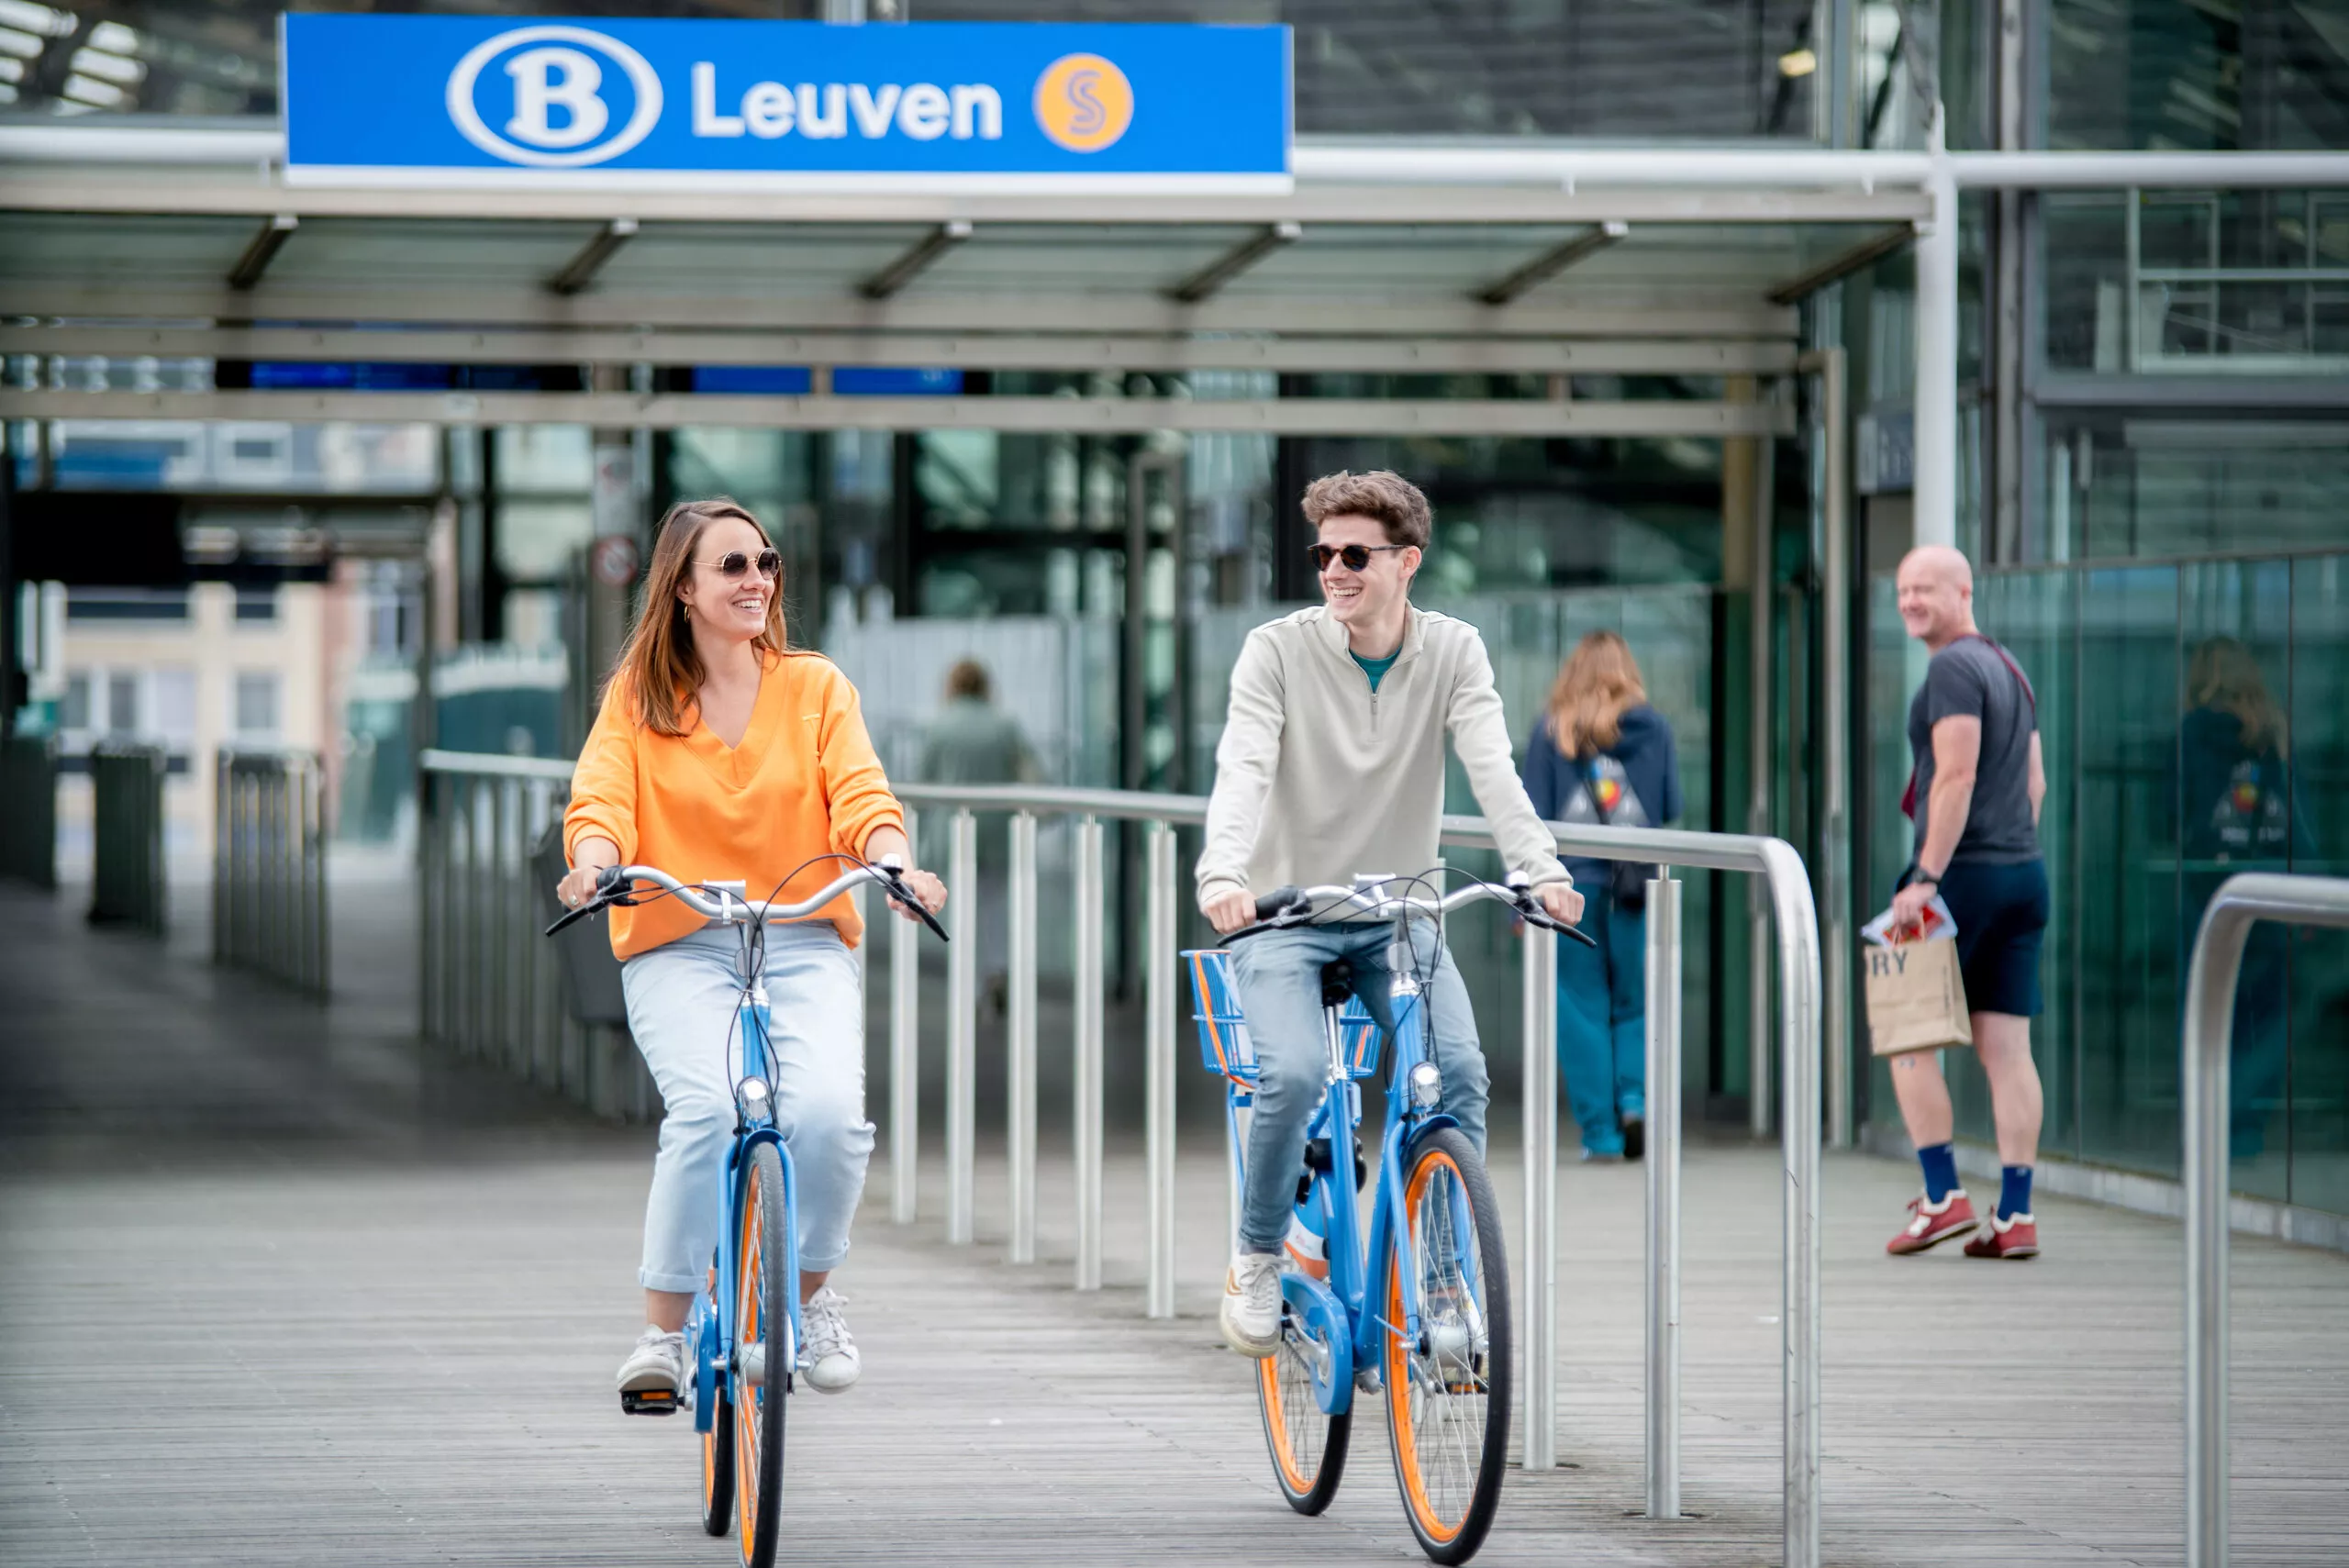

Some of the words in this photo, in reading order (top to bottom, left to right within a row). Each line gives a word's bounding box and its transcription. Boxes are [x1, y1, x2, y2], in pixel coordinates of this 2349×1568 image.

[506, 49, 608, 148] B
[692, 61, 1003, 140] Leuven
[1067, 69, 1107, 135] S
